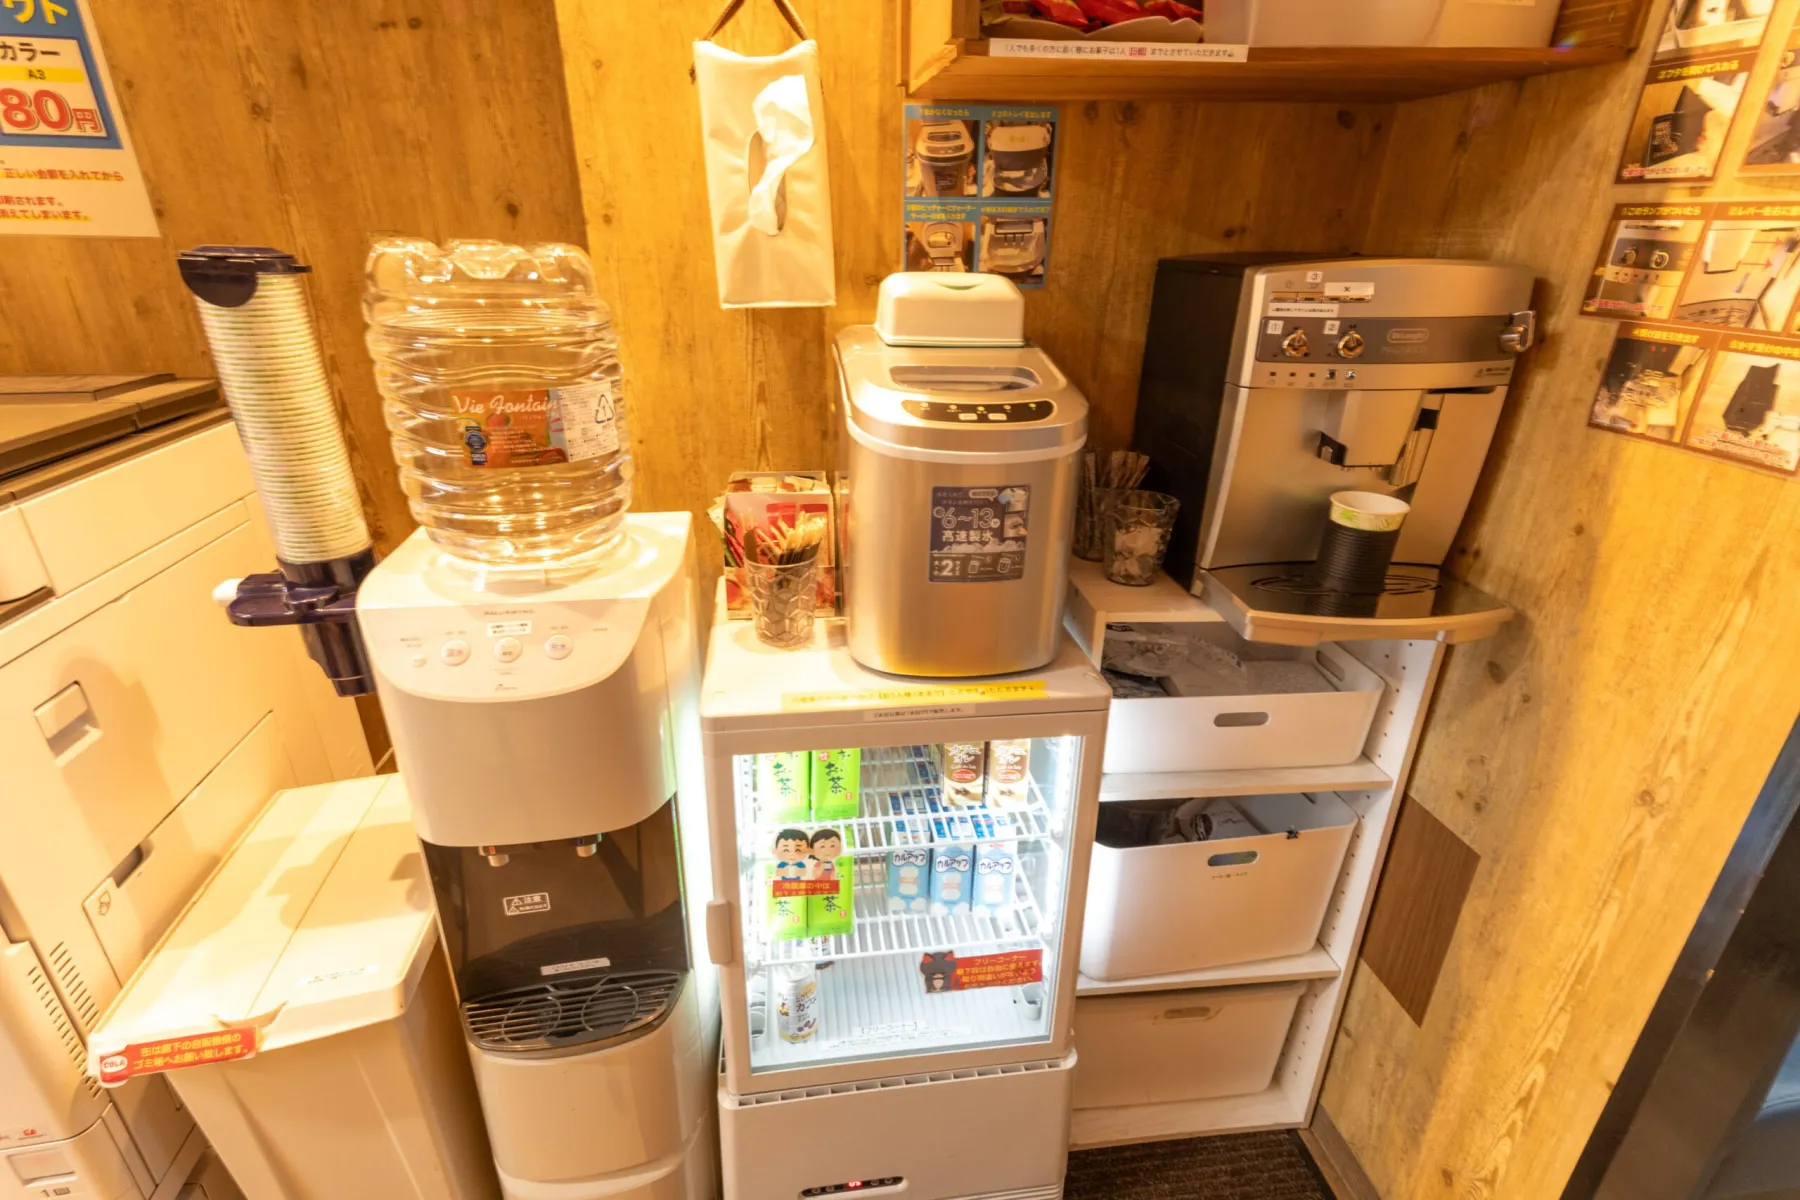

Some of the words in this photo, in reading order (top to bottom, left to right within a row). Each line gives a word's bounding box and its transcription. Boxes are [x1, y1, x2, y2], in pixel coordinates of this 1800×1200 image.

[452, 395, 486, 414] Vie
[941, 560, 954, 577] 2
[974, 955, 1027, 965] フリーコーナー
